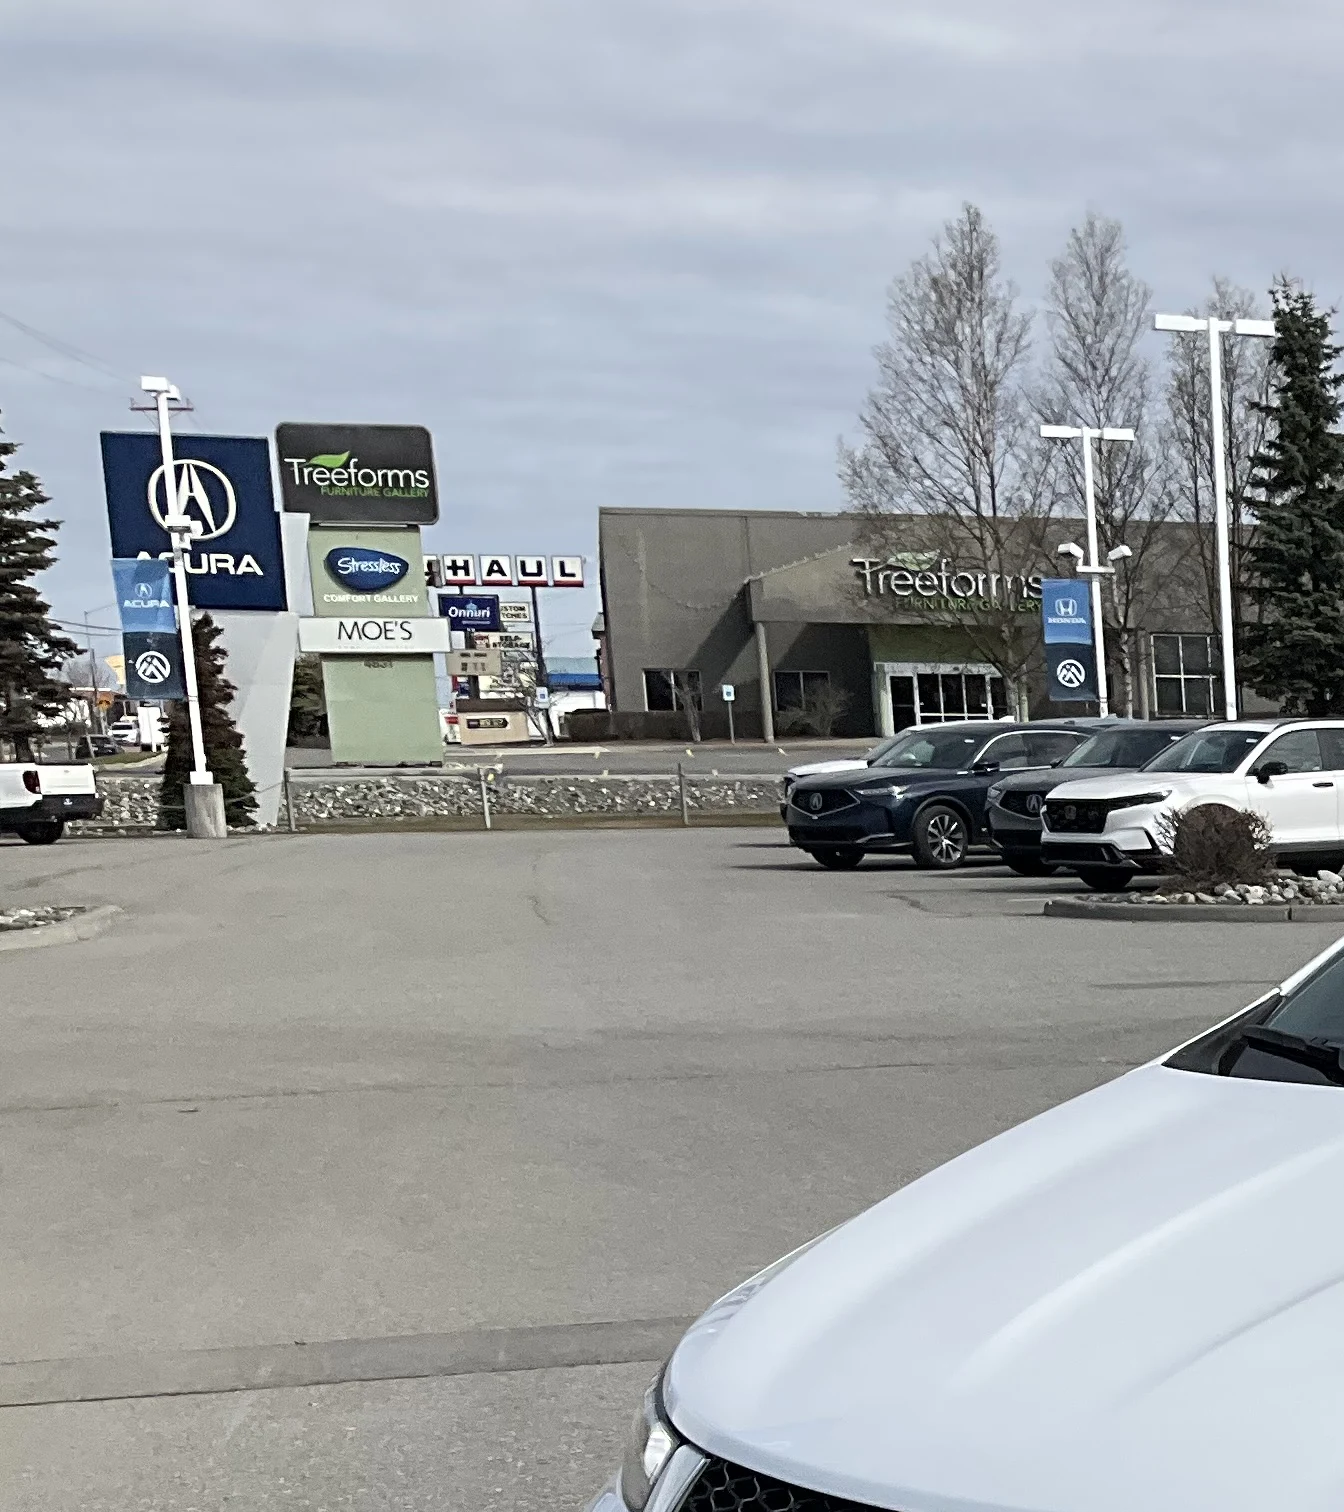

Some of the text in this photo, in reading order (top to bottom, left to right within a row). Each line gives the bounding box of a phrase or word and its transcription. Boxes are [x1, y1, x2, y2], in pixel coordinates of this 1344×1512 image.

[284, 458, 430, 489] Treeforms
[320, 486, 429, 498] FURNITURE GALLERY
[337, 557, 401, 574] Stressless
[852, 558, 1043, 598] Treeforms
[123, 599, 170, 608] ACURA
[323, 593, 419, 604] COMFORT GALLERY
[448, 606, 491, 618] Onnuri
[1048, 616, 1087, 625] HONDA
[337, 620, 413, 641] MOE'S
